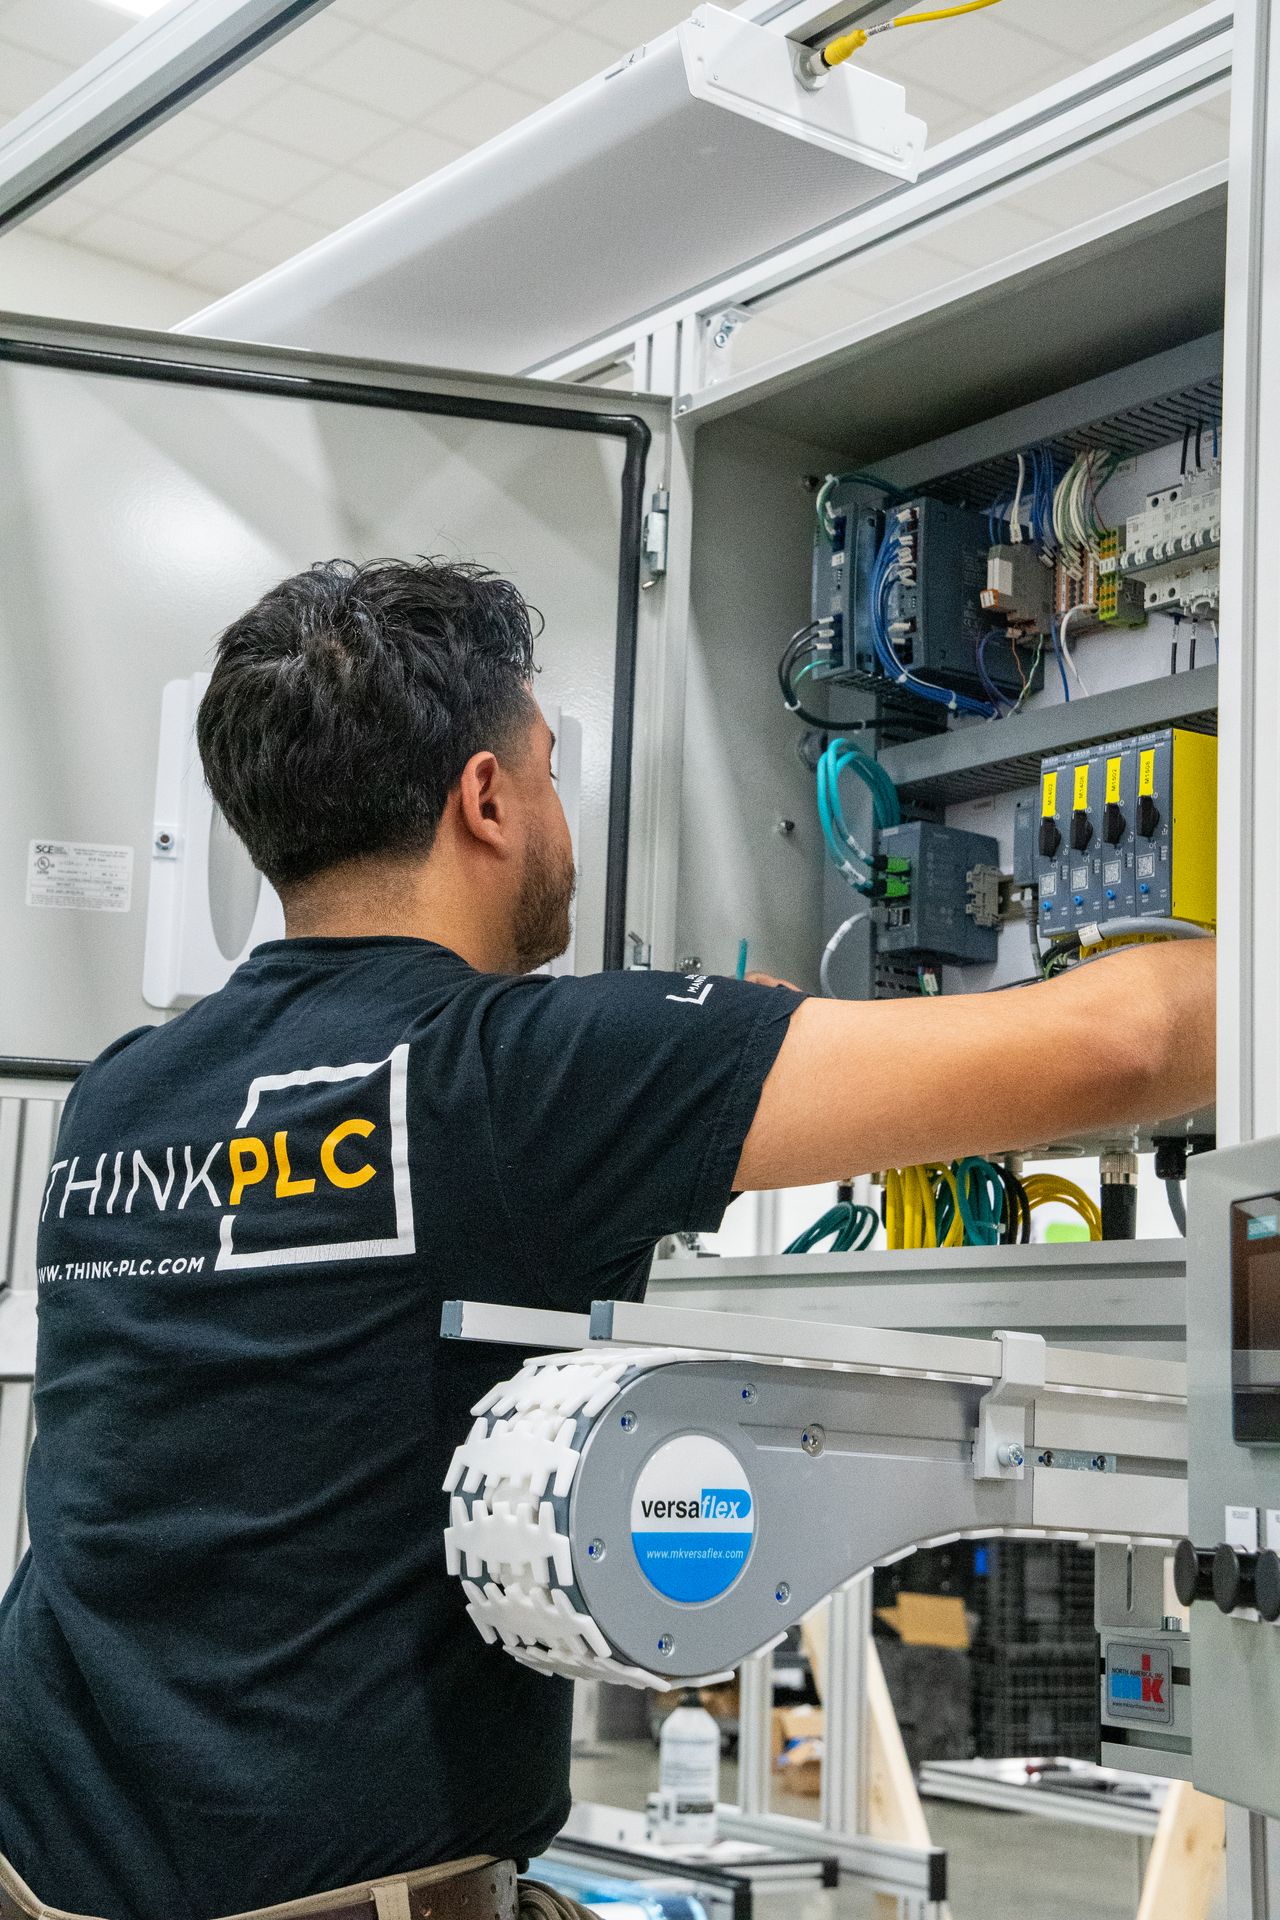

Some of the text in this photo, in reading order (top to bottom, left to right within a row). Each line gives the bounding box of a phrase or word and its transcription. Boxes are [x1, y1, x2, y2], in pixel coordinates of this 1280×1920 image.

[36, 845, 54, 854] SCE
[38, 1256, 205, 1285] WW.THINK-PLC.COM
[641, 1495, 741, 1519] versaflex
[646, 1548, 744, 1560] www.mkversaflex.com
[1111, 1667, 1129, 1675] NORTH
